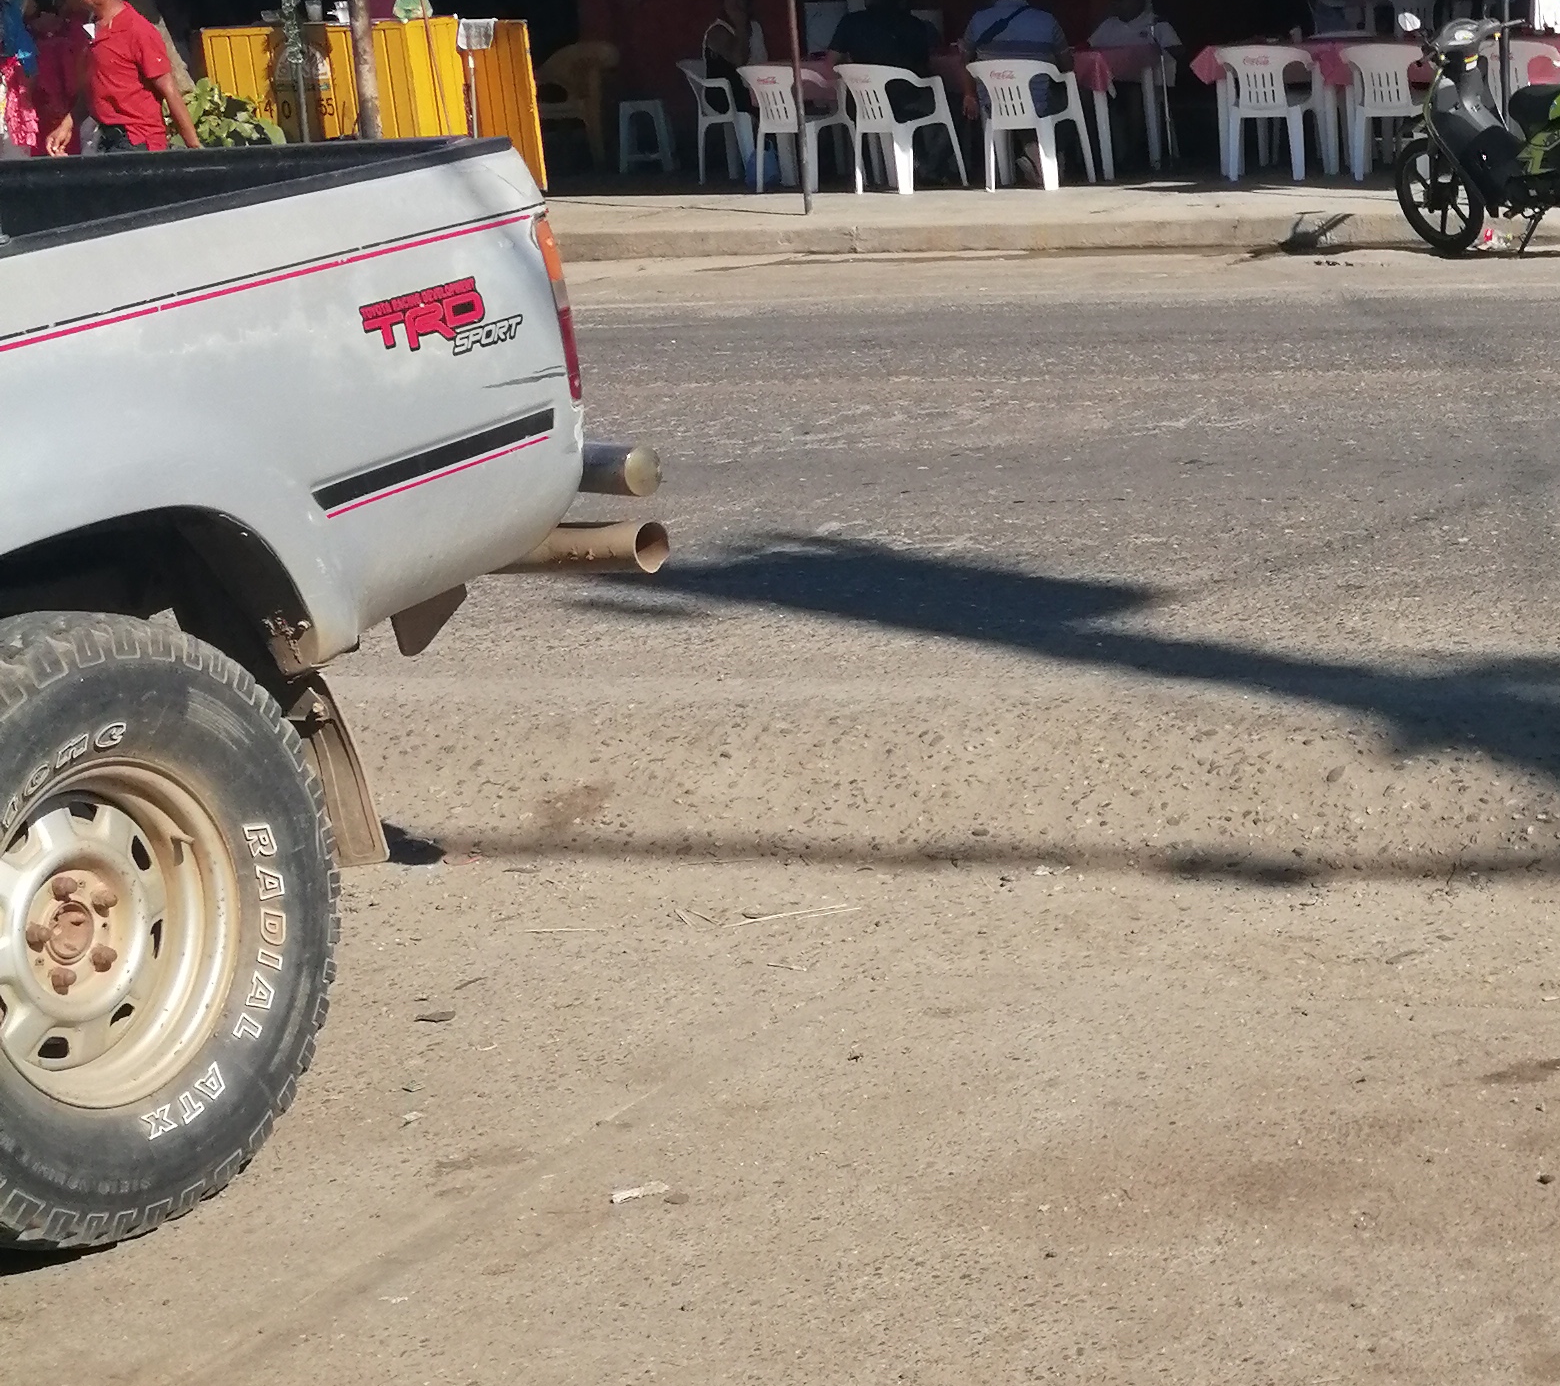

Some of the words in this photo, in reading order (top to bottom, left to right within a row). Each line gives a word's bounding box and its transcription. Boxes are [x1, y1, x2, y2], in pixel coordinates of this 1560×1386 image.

[362, 290, 485, 352] TRD
[452, 313, 523, 356] SPORT
[233, 824, 287, 1040] RADIAL
[139, 1061, 225, 1141] ATX
